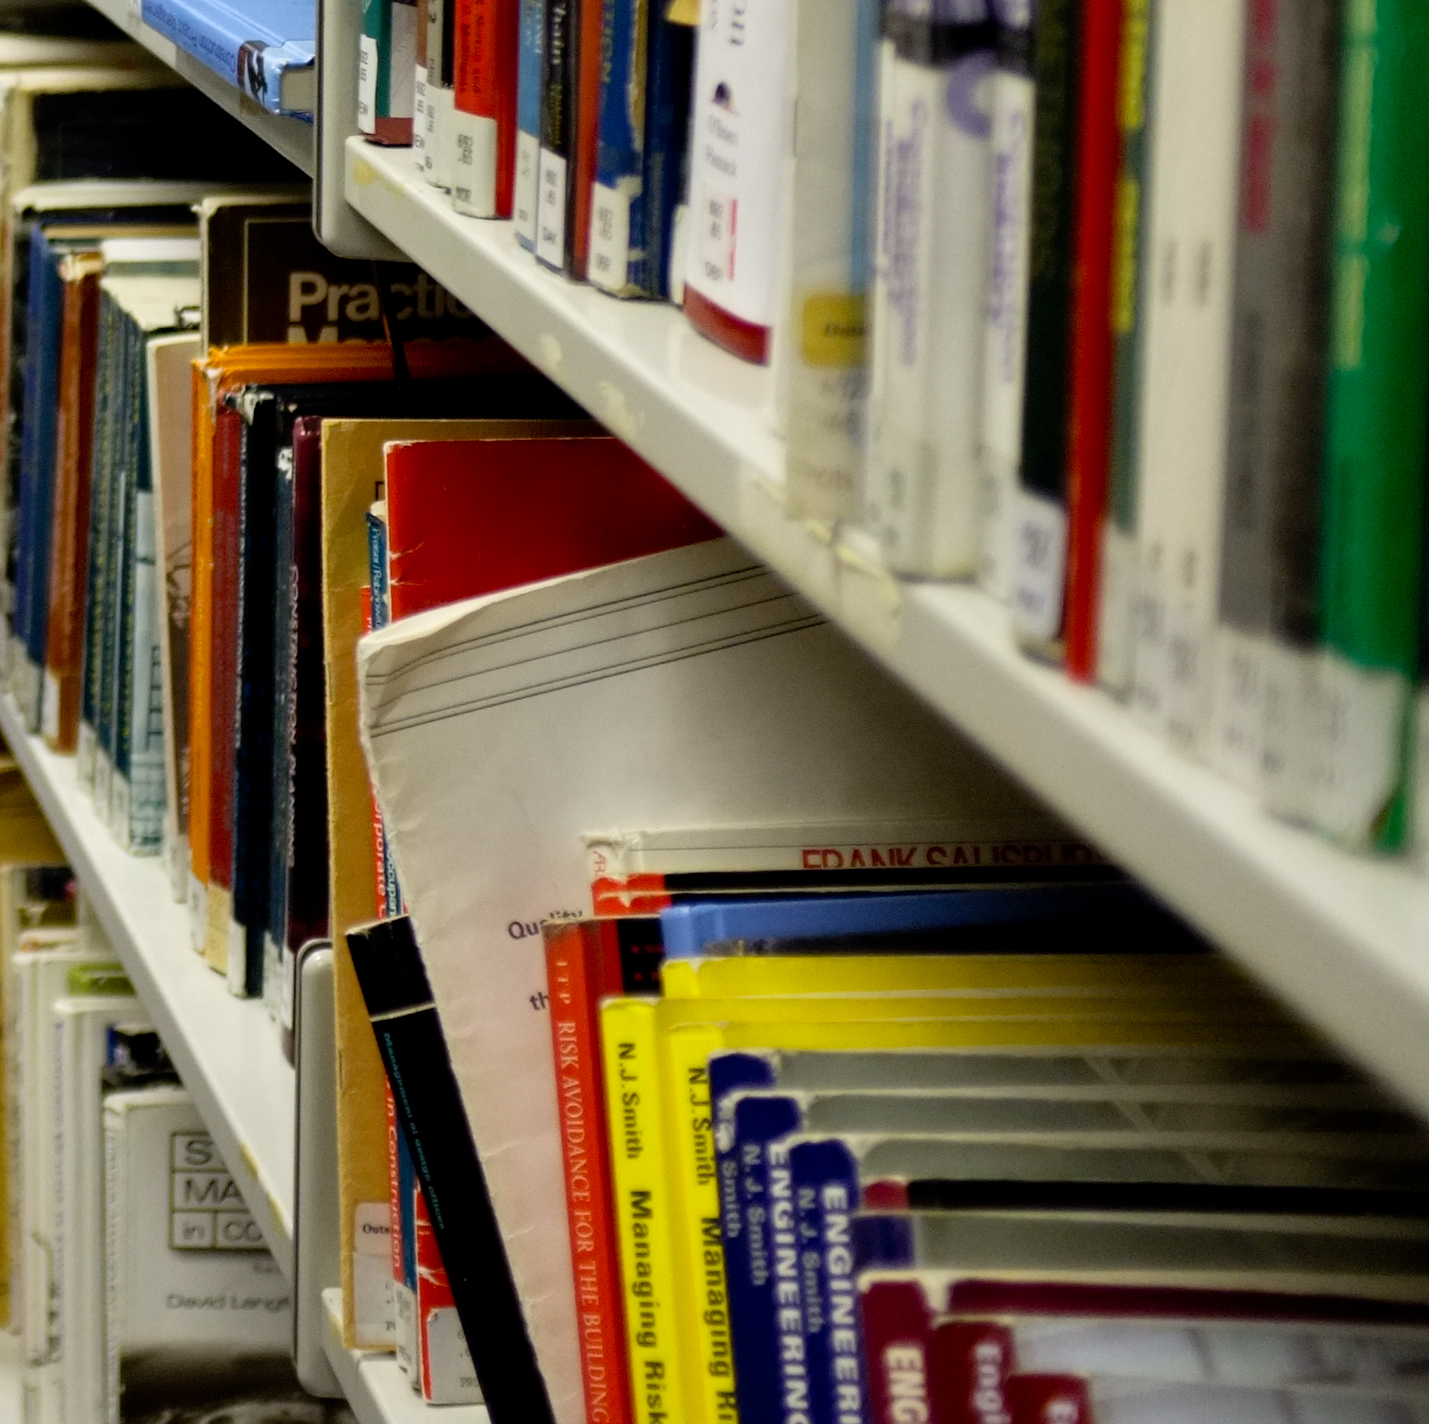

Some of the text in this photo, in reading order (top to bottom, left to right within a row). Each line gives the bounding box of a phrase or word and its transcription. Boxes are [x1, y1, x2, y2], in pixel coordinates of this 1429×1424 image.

[286, 565, 299, 745] CONSTRUCTION
[372, 799, 389, 905] orporate
[388, 1125, 406, 1269] Construction
[382, 1032, 415, 1117] Management
[556, 1020, 611, 1424] RISK AVOIDANCE FOR THE BUILDING
[629, 1189, 663, 1349] Managing
[721, 1159, 742, 1238] Smith
[747, 1204, 771, 1286] Smith
[701, 1216, 735, 1378] Managing
[801, 1249, 825, 1333] Smith
